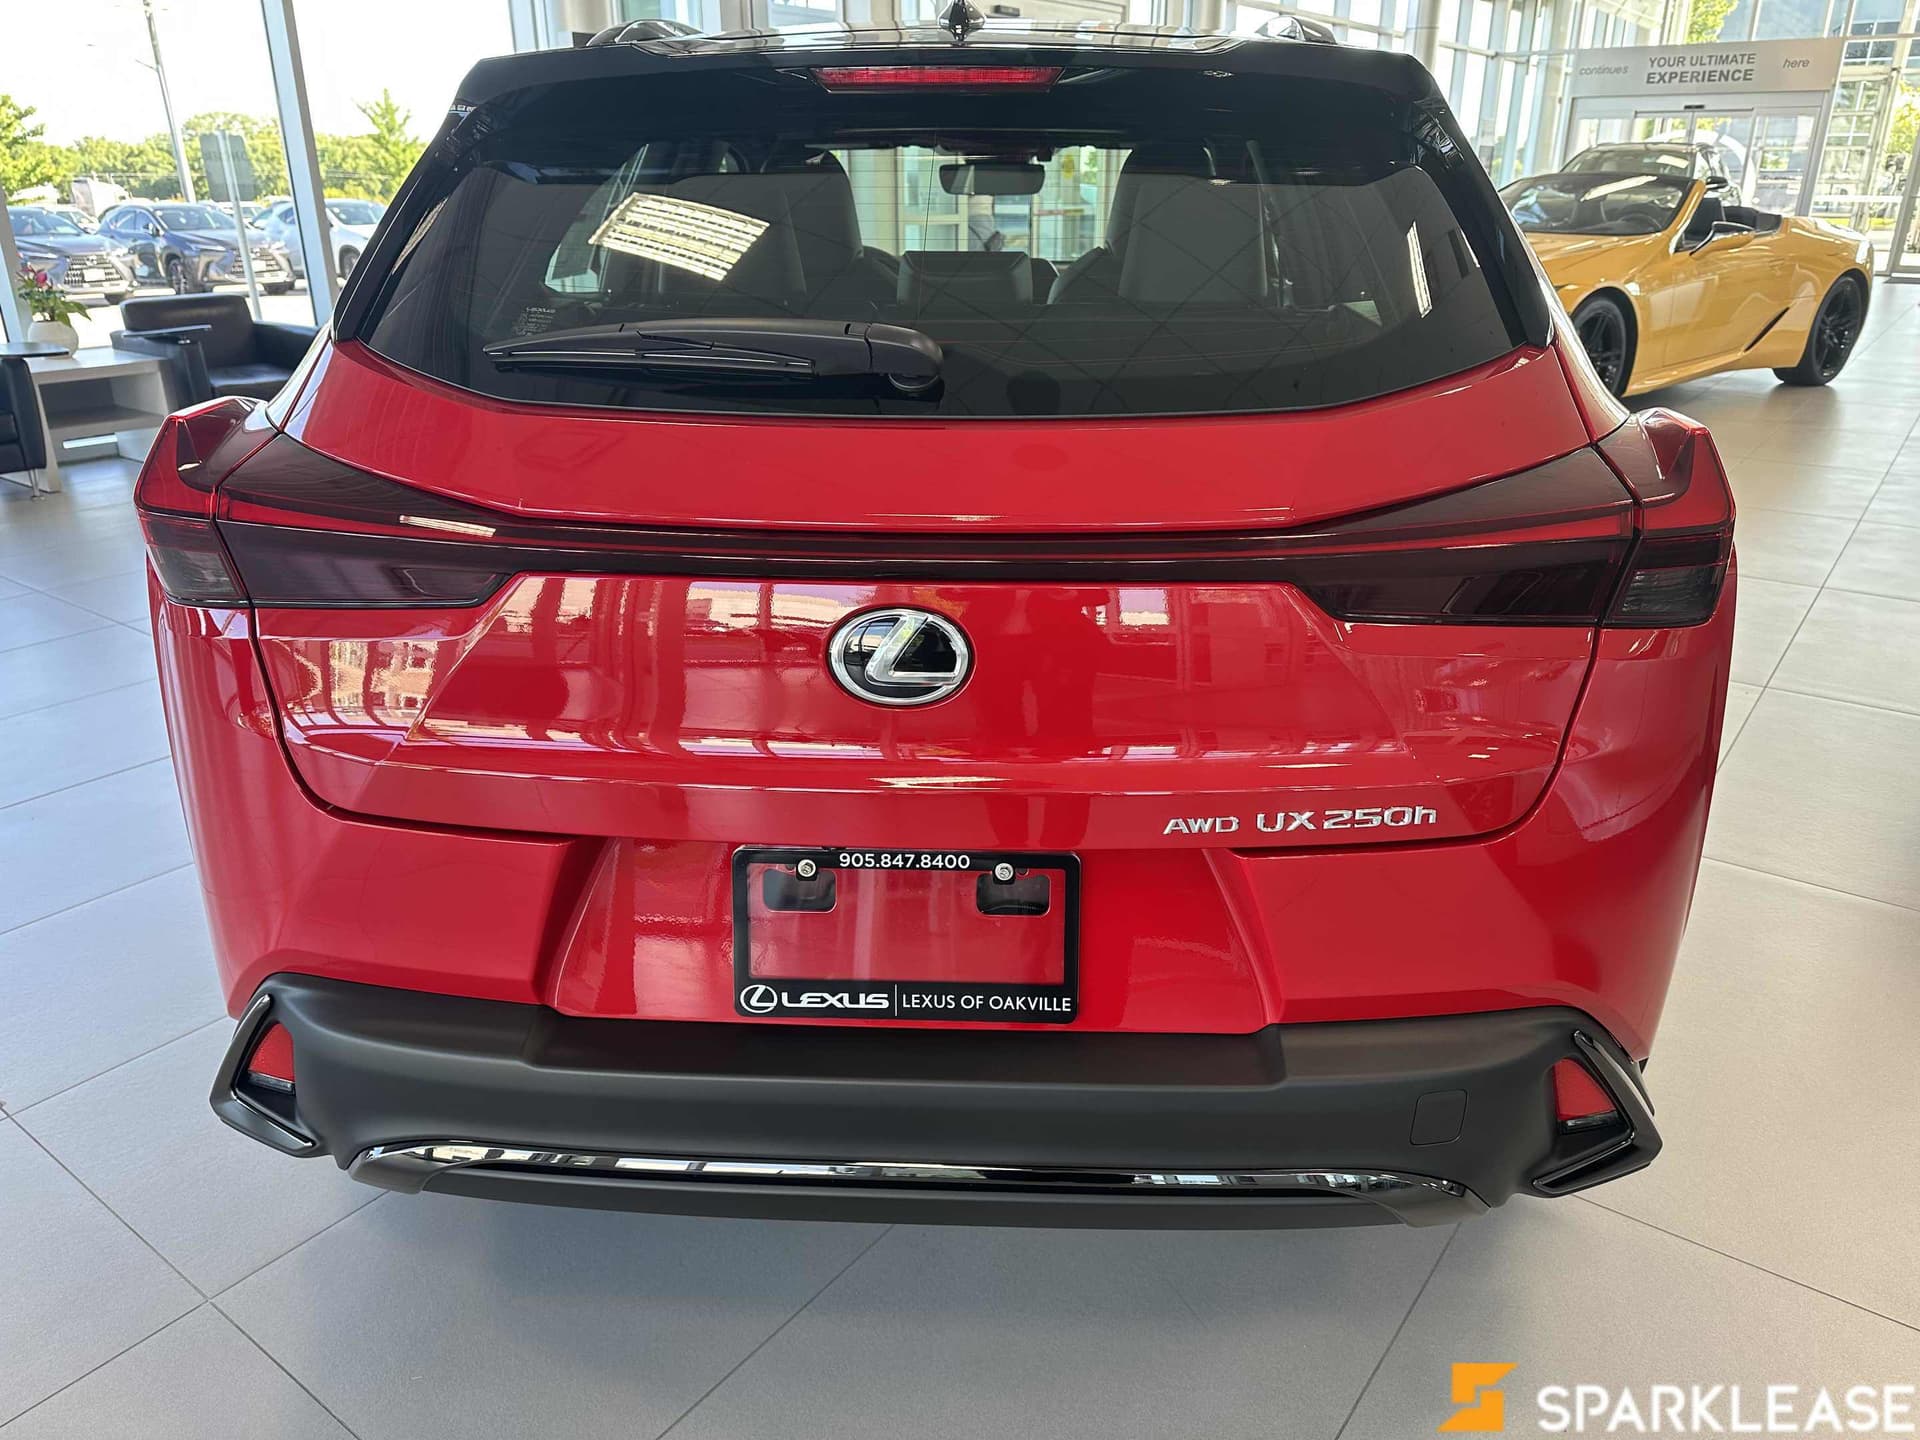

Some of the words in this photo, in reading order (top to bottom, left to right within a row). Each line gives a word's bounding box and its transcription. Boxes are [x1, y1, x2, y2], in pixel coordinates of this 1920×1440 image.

[1649, 56, 1686, 68] YOUR
[1689, 53, 1756, 67] ULTIMATE
[1782, 57, 1810, 69] here
[1579, 64, 1629, 76] continues
[1646, 69, 1754, 84] EXPERIENCE
[1163, 816, 1240, 834] AWD
[1257, 811, 1316, 832] UX
[1323, 805, 1437, 829] 250h
[839, 853, 970, 870] 905.847.8400
[781, 992, 890, 1009] LEXUS
[902, 994, 955, 1009] LEXUS
[960, 995, 984, 1009] OF
[988, 995, 1072, 1012] OAKVILLE
